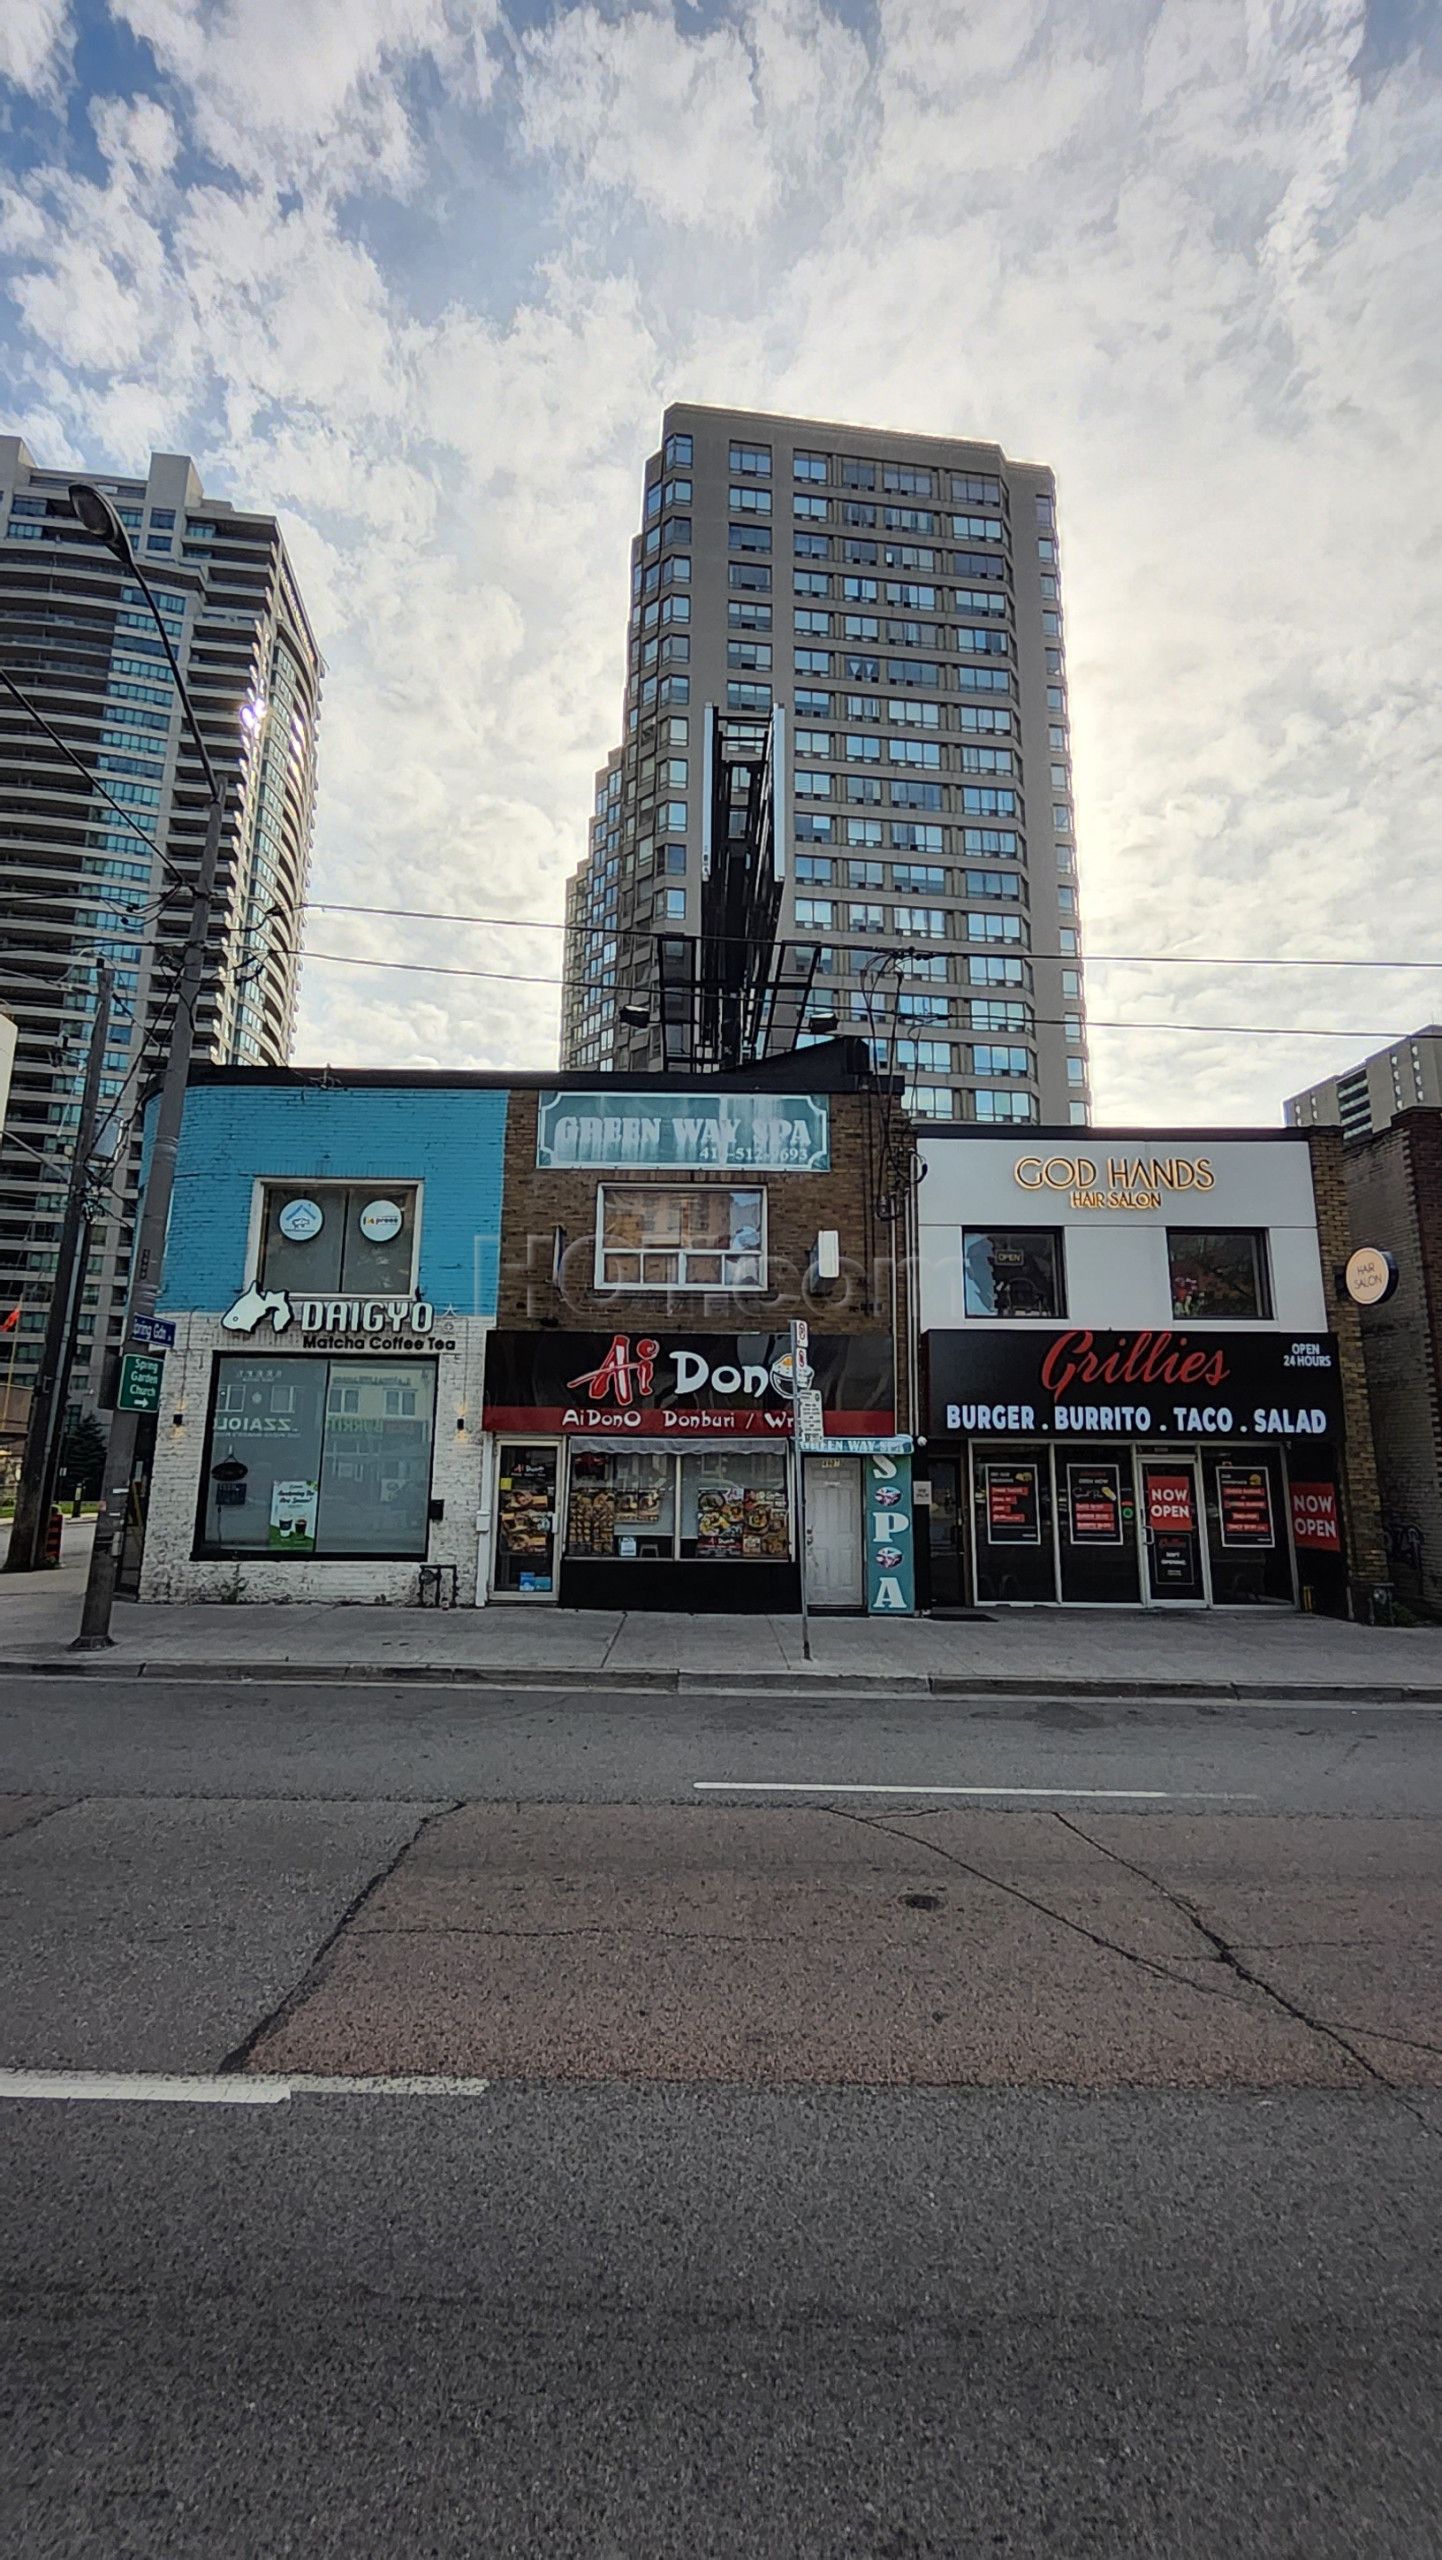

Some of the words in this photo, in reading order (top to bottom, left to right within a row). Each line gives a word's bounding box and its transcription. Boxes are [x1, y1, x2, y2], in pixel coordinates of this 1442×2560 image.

[554, 1115, 662, 1145] GREEN
[672, 1118, 742, 1146] WAY
[752, 1119, 812, 1146] SPA
[699, 1147, 808, 1162] 41-512-693
[1014, 1155, 1098, 1190] GOD
[1107, 1156, 1216, 1191] HANDS
[1071, 1190, 1105, 1208] HAIR
[1107, 1190, 1163, 1209] SALON
[998, 1253, 1021, 1262] OPEN
[1357, 1263, 1375, 1274] HAIR
[1354, 1274, 1383, 1289] SALON
[302, 1301, 434, 1333] DAIGYO
[303, 1336, 365, 1350] Matcha
[369, 1336, 424, 1350] Coffee
[428, 1337, 456, 1350] Tea
[1291, 1343, 1320, 1355] OPEN
[135, 1358, 158, 1374] Spring
[1041, 1330, 1231, 1403] Grillies
[1283, 1355, 1296, 1367] 24
[1297, 1355, 1332, 1367] HOURS
[567, 1334, 660, 1406] Ai
[131, 1371, 158, 1385] Garden
[130, 1384, 156, 1397] Church
[663, 1410, 735, 1429] Donburi
[946, 1404, 1035, 1430] BURGER
[1054, 1405, 1151, 1431] BURRITO
[1174, 1407, 1233, 1432] TACO
[1254, 1408, 1327, 1434] SALAD
[848, 1440, 876, 1451] WAY
[1151, 1488, 1188, 1502] NOW
[1150, 1504, 1190, 1518] OPEN
[1293, 1495, 1333, 1513] NOW
[1294, 1517, 1337, 1538] OPEN
